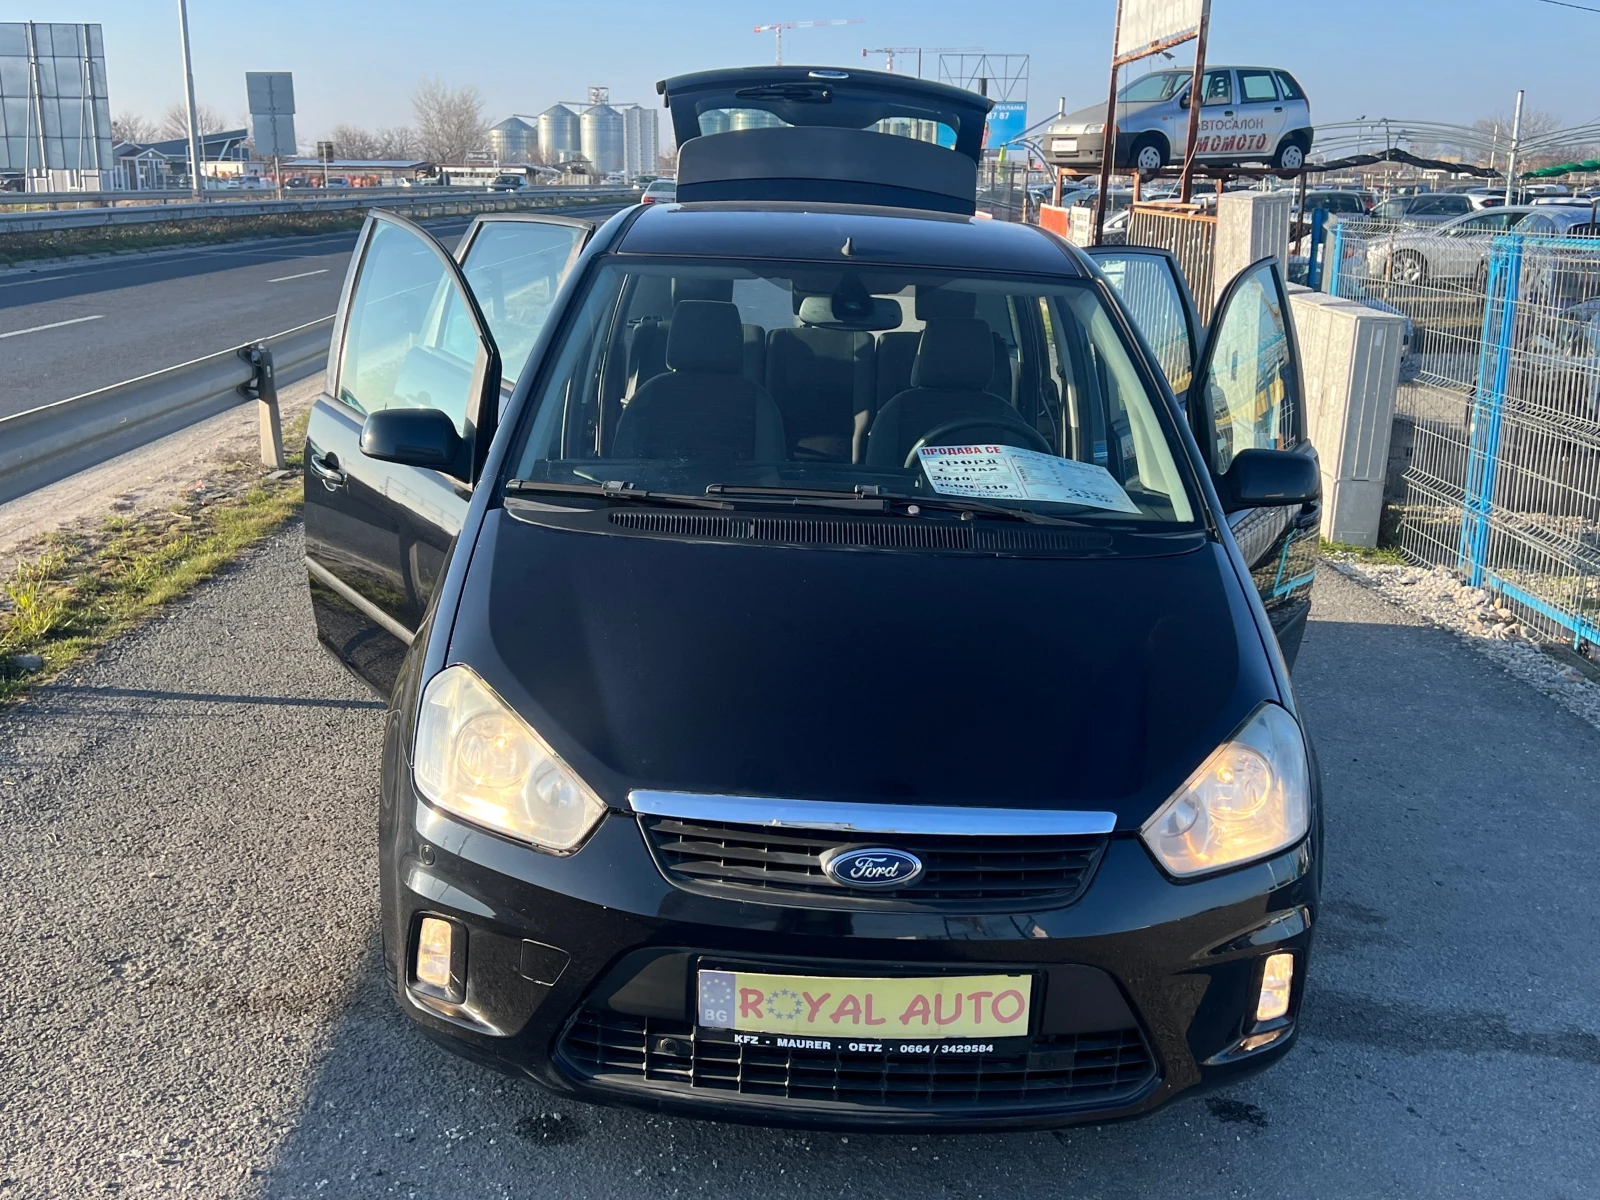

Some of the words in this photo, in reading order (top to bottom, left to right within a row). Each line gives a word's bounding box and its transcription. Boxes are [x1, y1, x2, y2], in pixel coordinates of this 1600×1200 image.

[999, 112, 1010, 120] 87
[1199, 118, 1264, 131] ВТОСАЛОН
[921, 447, 982, 456] ПРОДАВА
[985, 446, 1002, 454] СЕ
[850, 857, 899, 878] Ford
[738, 987, 886, 1026] ROYAL
[898, 989, 1026, 1026] AUTO
[704, 1008, 728, 1023] BG
[734, 1033, 759, 1045] KFZ
[777, 1037, 832, 1050] MAURER
[848, 1042, 883, 1053] OETZ
[899, 1043, 931, 1054] 0664
[941, 1042, 994, 1054] 3429584
